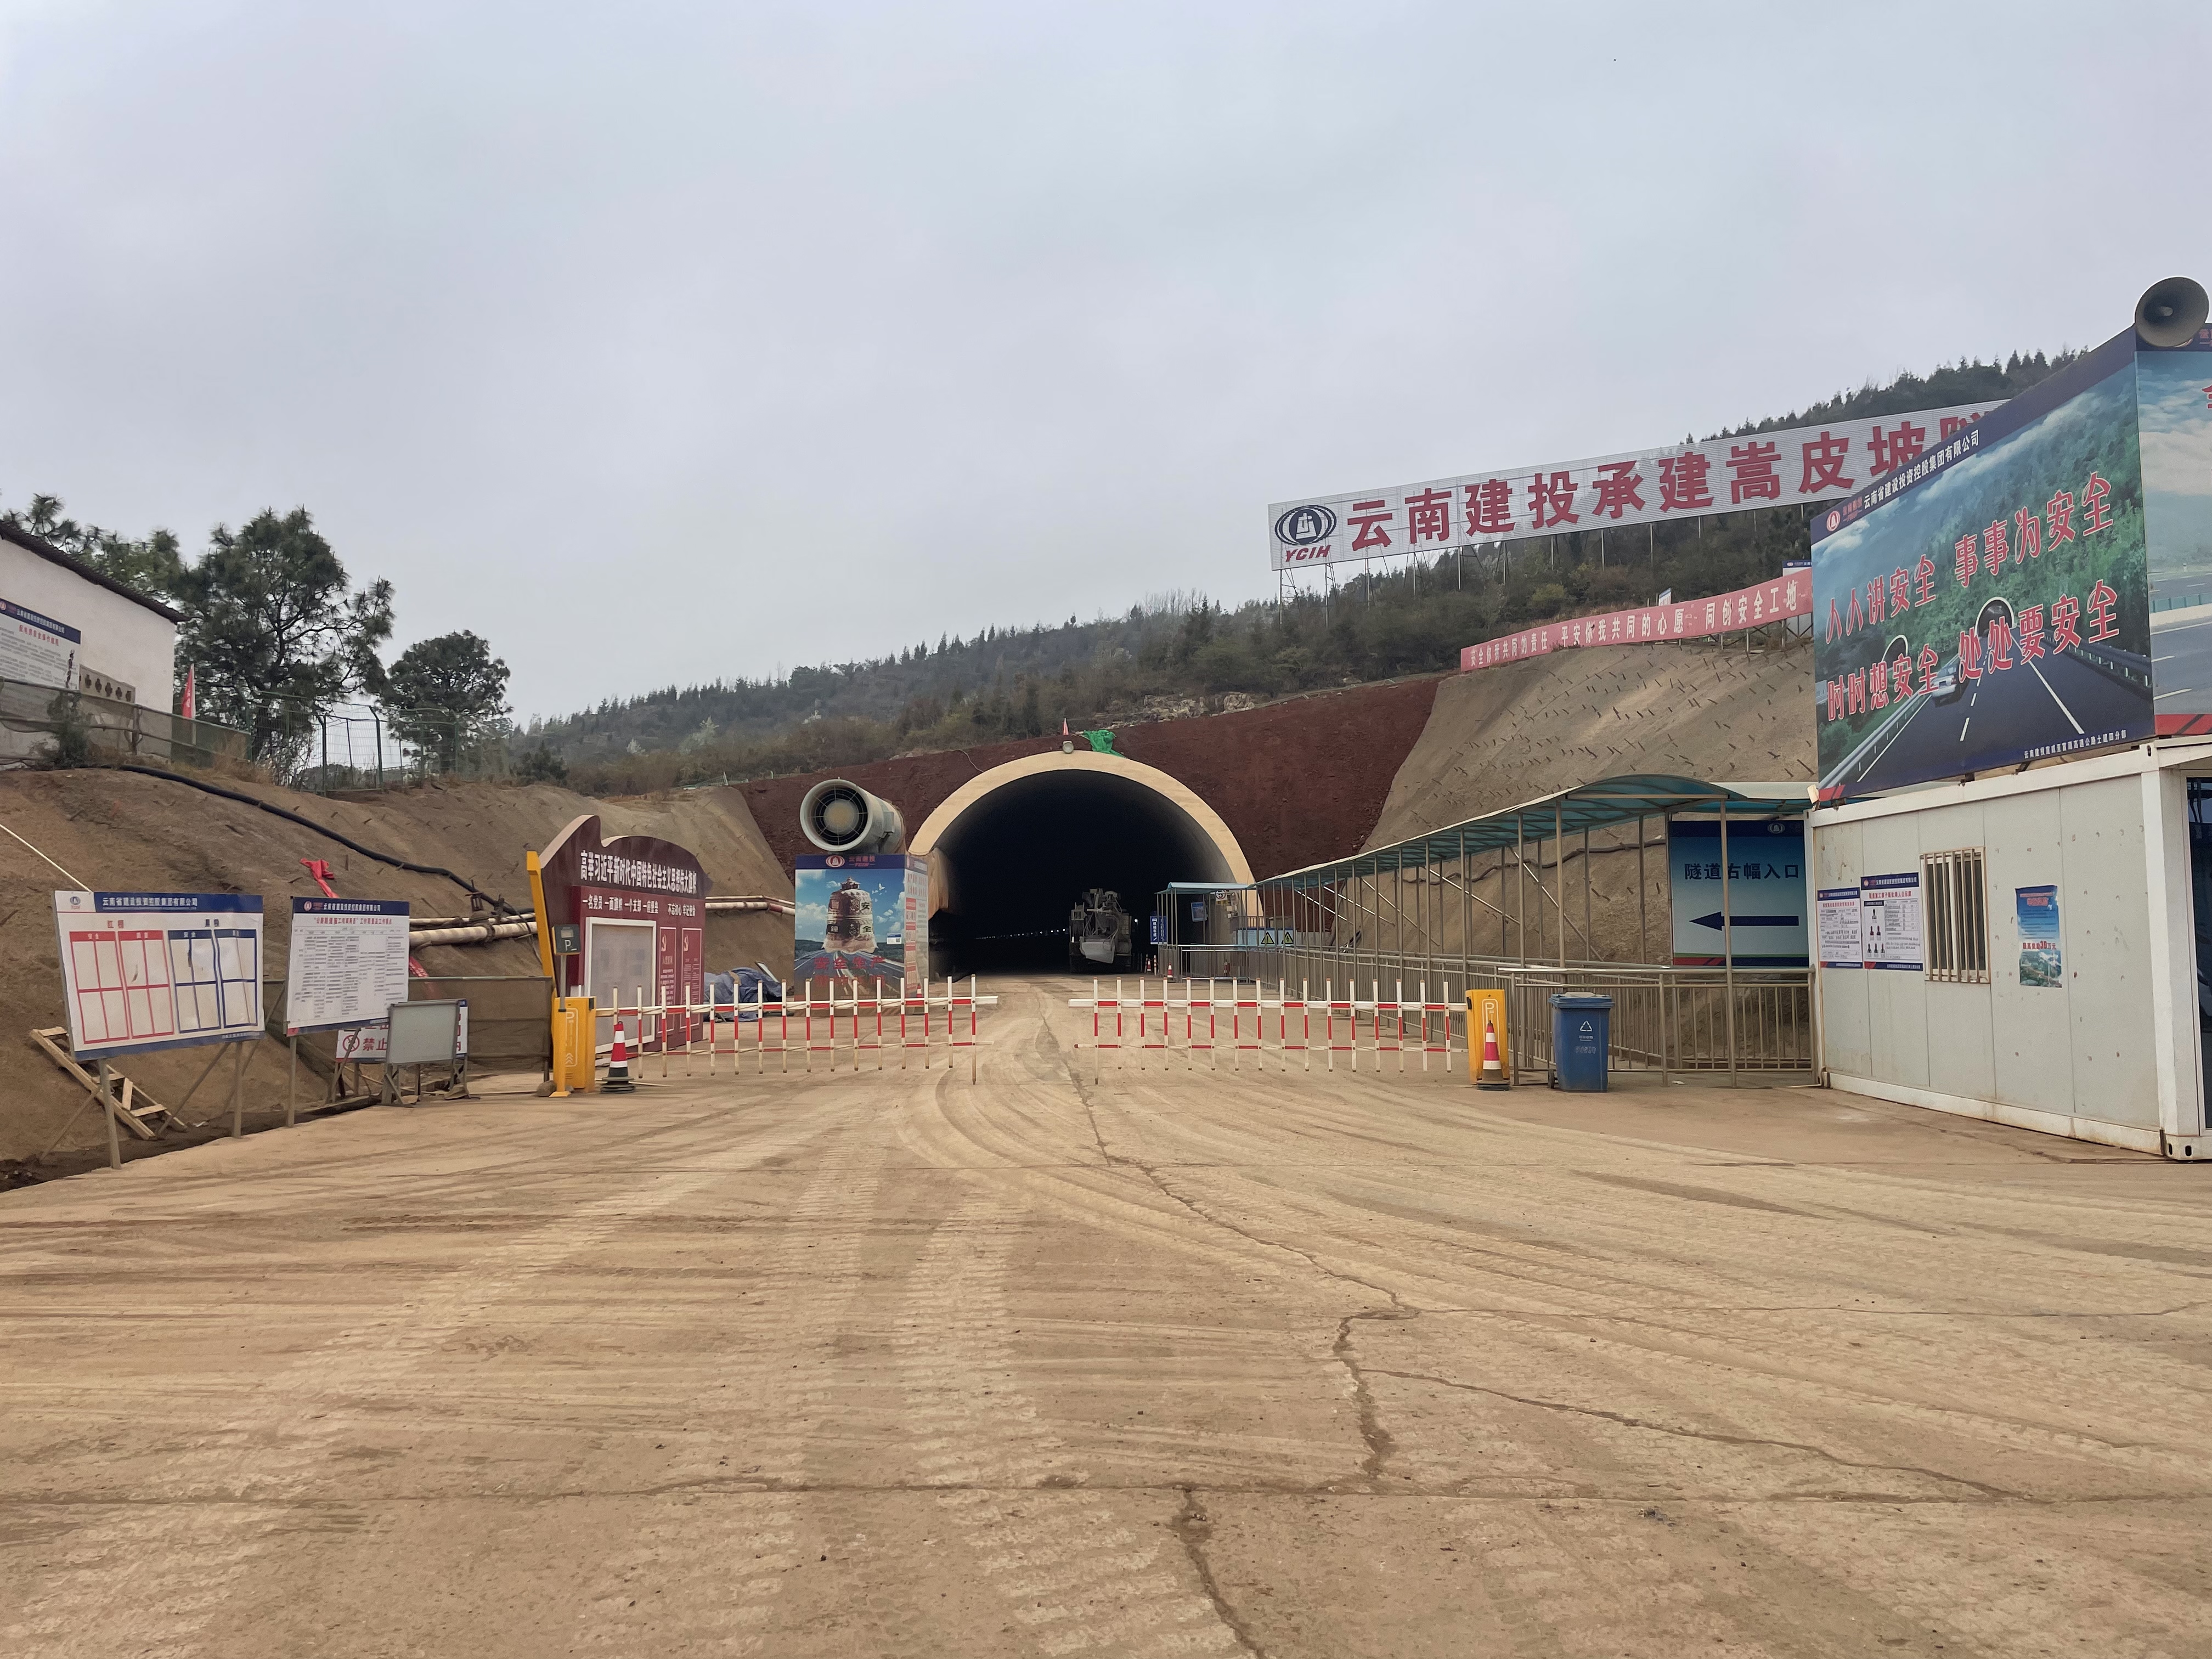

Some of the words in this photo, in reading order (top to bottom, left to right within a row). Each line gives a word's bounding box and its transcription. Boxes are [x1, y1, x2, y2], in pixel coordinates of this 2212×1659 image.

[1864, 430, 1979, 510] 云南省建设投资控股集团有限公司
[1285, 545, 1331, 562] YCIH
[1826, 554, 1937, 645] 人人讲安全
[1954, 471, 2114, 588] 事事为安全
[1470, 630, 1548, 667] 安全你我共同的责任
[1561, 608, 1685, 647] 平安你我共同的心愿
[1706, 579, 1799, 630] 同创安全工地
[1827, 644, 1939, 722] 时时想安全
[1957, 578, 2120, 684] 处处要安全
[580, 850, 697, 894] 高举习近平新时代中国特色社会主义思想伟大旗帜
[1684, 862, 1799, 881] 隧道右幅入口
[582, 894, 603, 910] 一名党员
[624, 898, 642, 913] 一个支部
[565, 940, 572, 951] P
[814, 956, 885, 969] 安全生产
